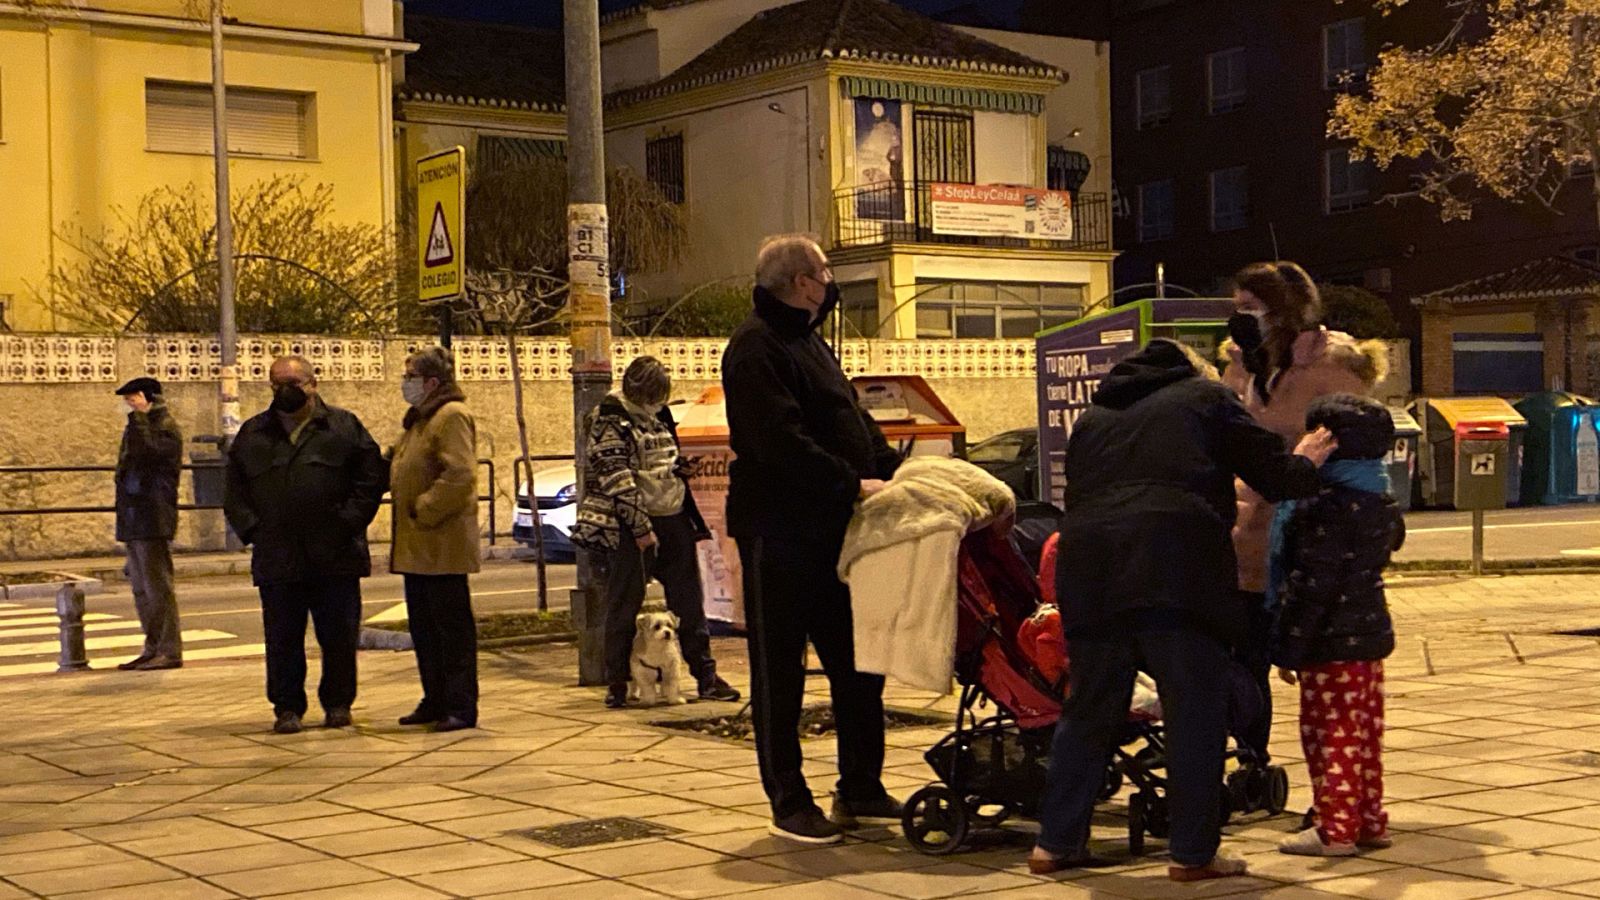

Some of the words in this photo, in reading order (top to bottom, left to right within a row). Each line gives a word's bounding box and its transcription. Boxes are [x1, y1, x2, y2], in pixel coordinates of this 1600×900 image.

[422, 271, 456, 289] COLEGIO
[1045, 356, 1057, 374] TU
[1058, 354, 1089, 378] ROPA
[1048, 409, 1062, 427] DE
